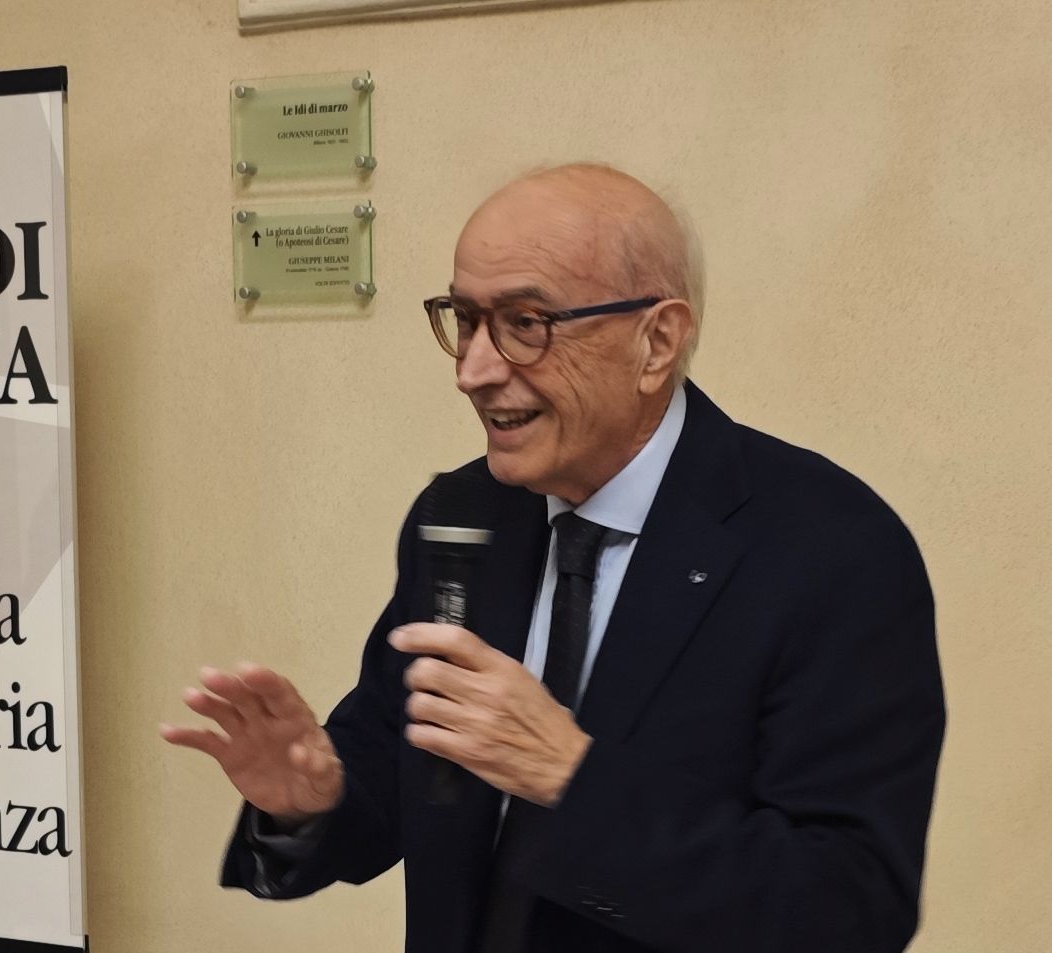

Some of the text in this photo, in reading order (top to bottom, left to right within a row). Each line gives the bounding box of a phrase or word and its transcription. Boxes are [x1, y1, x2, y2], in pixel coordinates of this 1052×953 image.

[283, 103, 349, 116] Le Idi di marzo
[277, 130, 314, 140] GIOVANNI
[266, 225, 349, 238] La gloria di Giulio Cesare
[275, 238, 284, 248] (o
[314, 236, 322, 246] di
[322, 235, 350, 245] Cesare)
[288, 255, 350, 265] GIUSEPPE MILANI
